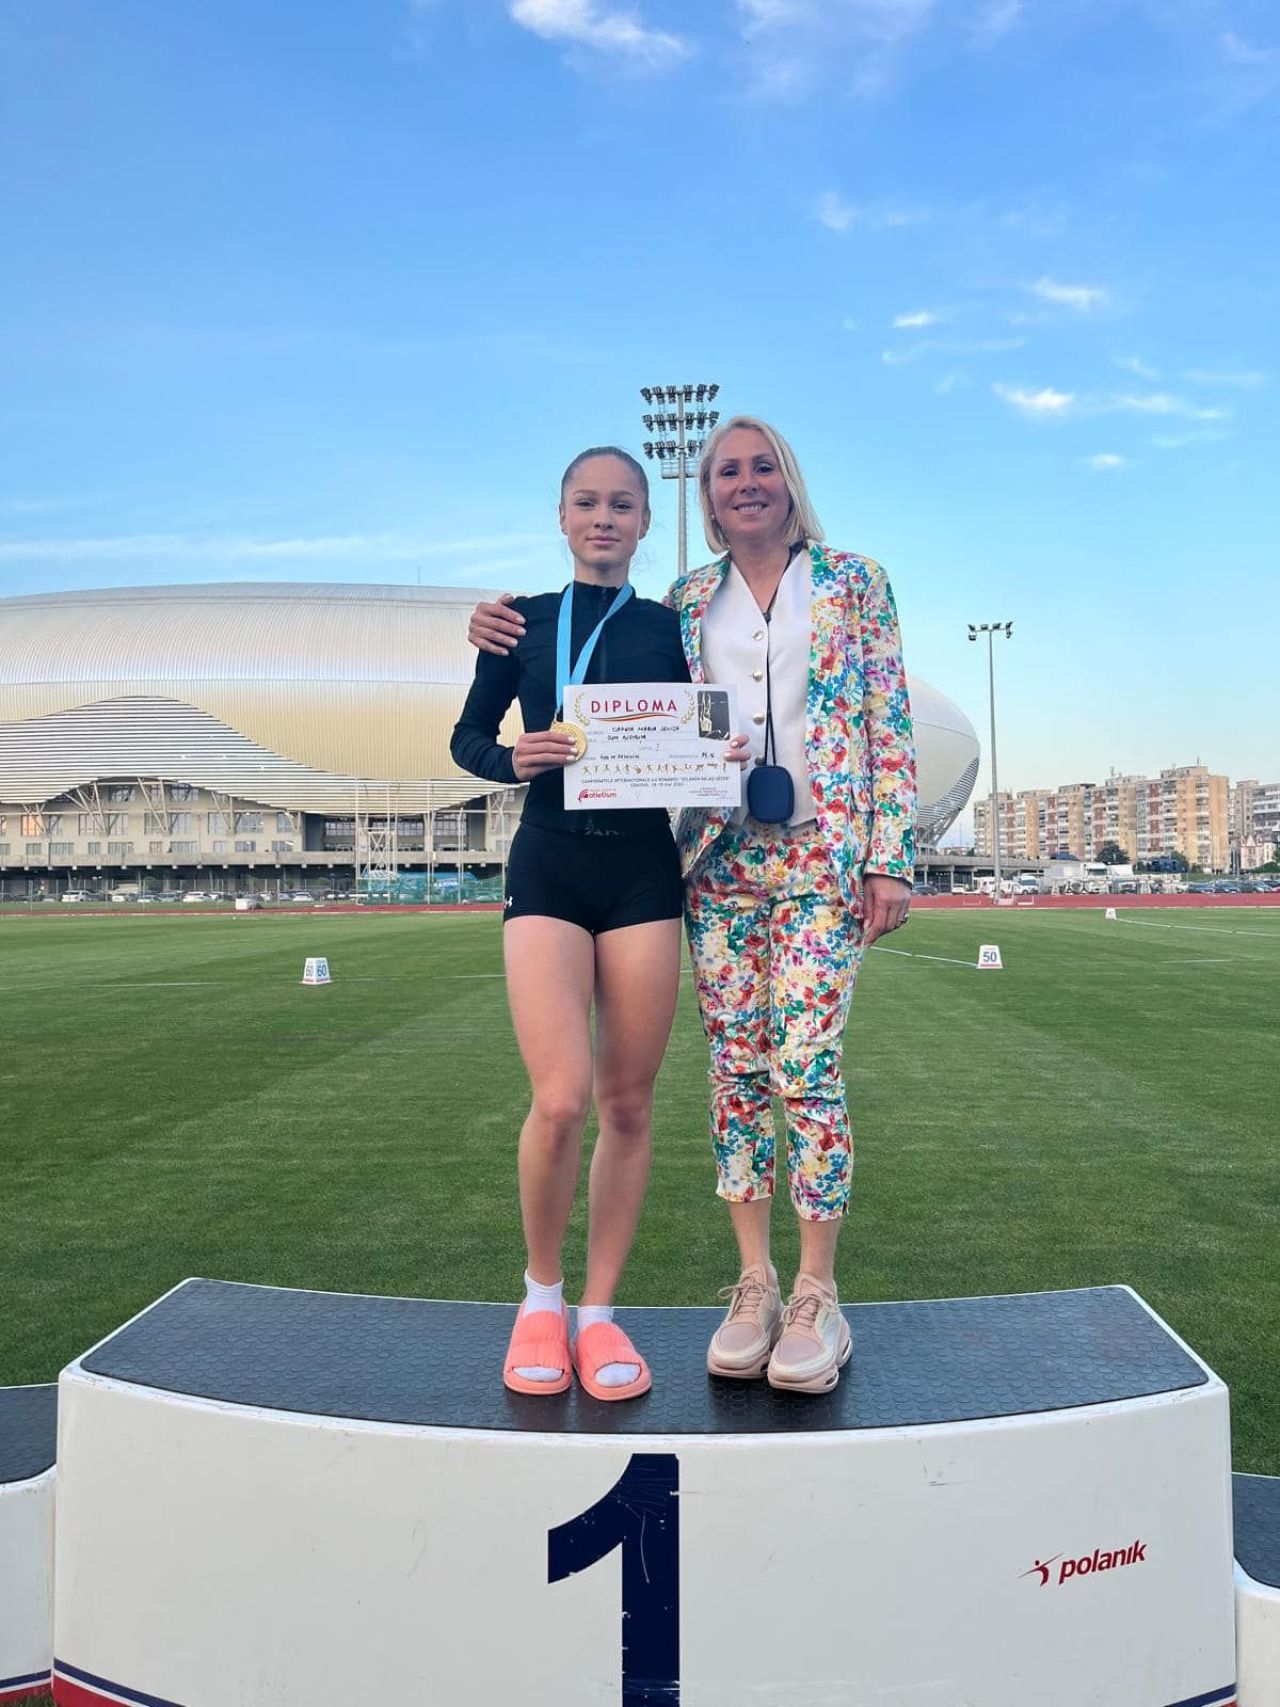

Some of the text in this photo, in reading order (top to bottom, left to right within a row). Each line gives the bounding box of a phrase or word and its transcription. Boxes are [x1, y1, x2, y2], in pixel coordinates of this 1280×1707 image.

[591, 699, 677, 713] DIPLOMA
[983, 951, 997, 962] 50
[317, 964, 327, 977] 60
[1059, 1539, 1147, 1585] polanik
[548, 1453, 681, 1707] 1
